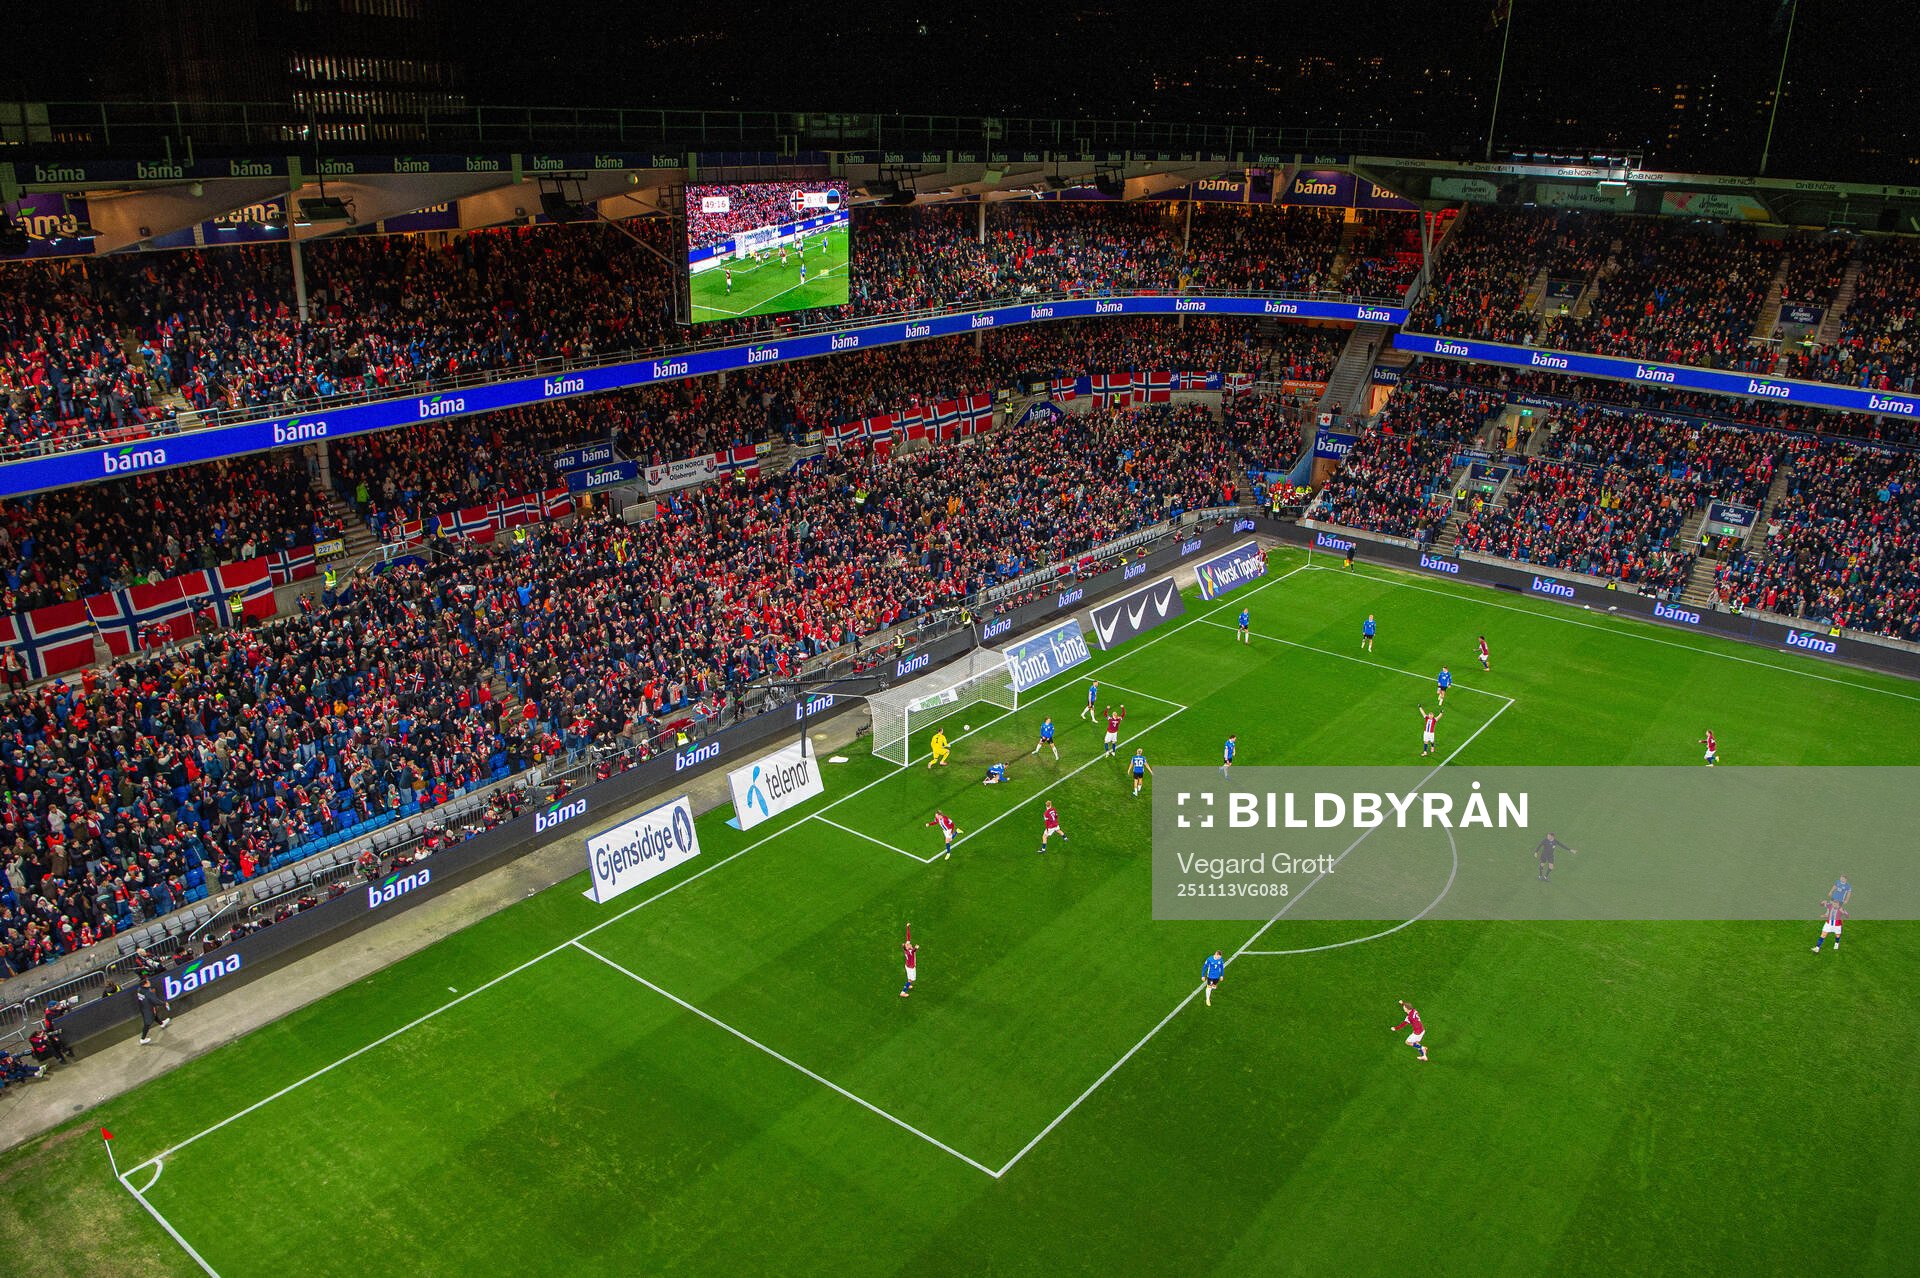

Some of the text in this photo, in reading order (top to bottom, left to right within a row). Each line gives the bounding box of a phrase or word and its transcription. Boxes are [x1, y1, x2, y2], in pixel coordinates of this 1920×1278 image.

[230, 159, 272, 177] bama
[394, 157, 430, 173] bama
[466, 156, 499, 171] bama
[533, 155, 564, 170] bama
[595, 154, 623, 169] bama
[652, 153, 678, 168] bama
[34, 163, 86, 182] bama
[1294, 178, 1336, 195] bama
[1371, 184, 1399, 198] ba
[15, 208, 78, 236] ama
[1031, 304, 1053, 319] bama
[1096, 300, 1123, 314] bama
[1175, 298, 1206, 311] bama
[1264, 300, 1298, 314] bama
[1357, 306, 1390, 321] bama
[972, 313, 994, 328] bama
[905, 322, 930, 338] bama
[831, 333, 859, 349] bama
[1434, 340, 1468, 356] bama
[748, 346, 779, 363] bama
[1531, 352, 1568, 369] bama
[653, 360, 688, 379] bama
[1636, 365, 1675, 383] bama
[544, 376, 584, 397] bama
[1747, 379, 1790, 397] bama
[419, 396, 465, 418] bama
[1868, 395, 1914, 415] bama
[273, 419, 327, 443] bama
[103, 446, 165, 473] bama
[553, 448, 610, 469] ama bama
[672, 464, 684, 472] FOR
[684, 459, 705, 470] NORGE
[586, 469, 620, 487] bama
[318, 545, 331, 554] 227
[1124, 562, 1146, 580] bama
[1420, 554, 1460, 574] bama
[1214, 561, 1240, 587] Norsk
[1532, 576, 1574, 598] bama
[1058, 587, 1083, 608] bama
[1654, 602, 1700, 624] bama
[983, 618, 1012, 640] bama
[1786, 629, 1837, 654] bama
[1050, 636, 1088, 668] bama
[897, 653, 929, 677] bama
[675, 741, 720, 771] bama
[766, 759, 810, 801] telenor
[535, 798, 587, 833] bama
[595, 822, 673, 886] Gjensidige
[368, 868, 431, 909] bama
[164, 953, 241, 1000] bama
